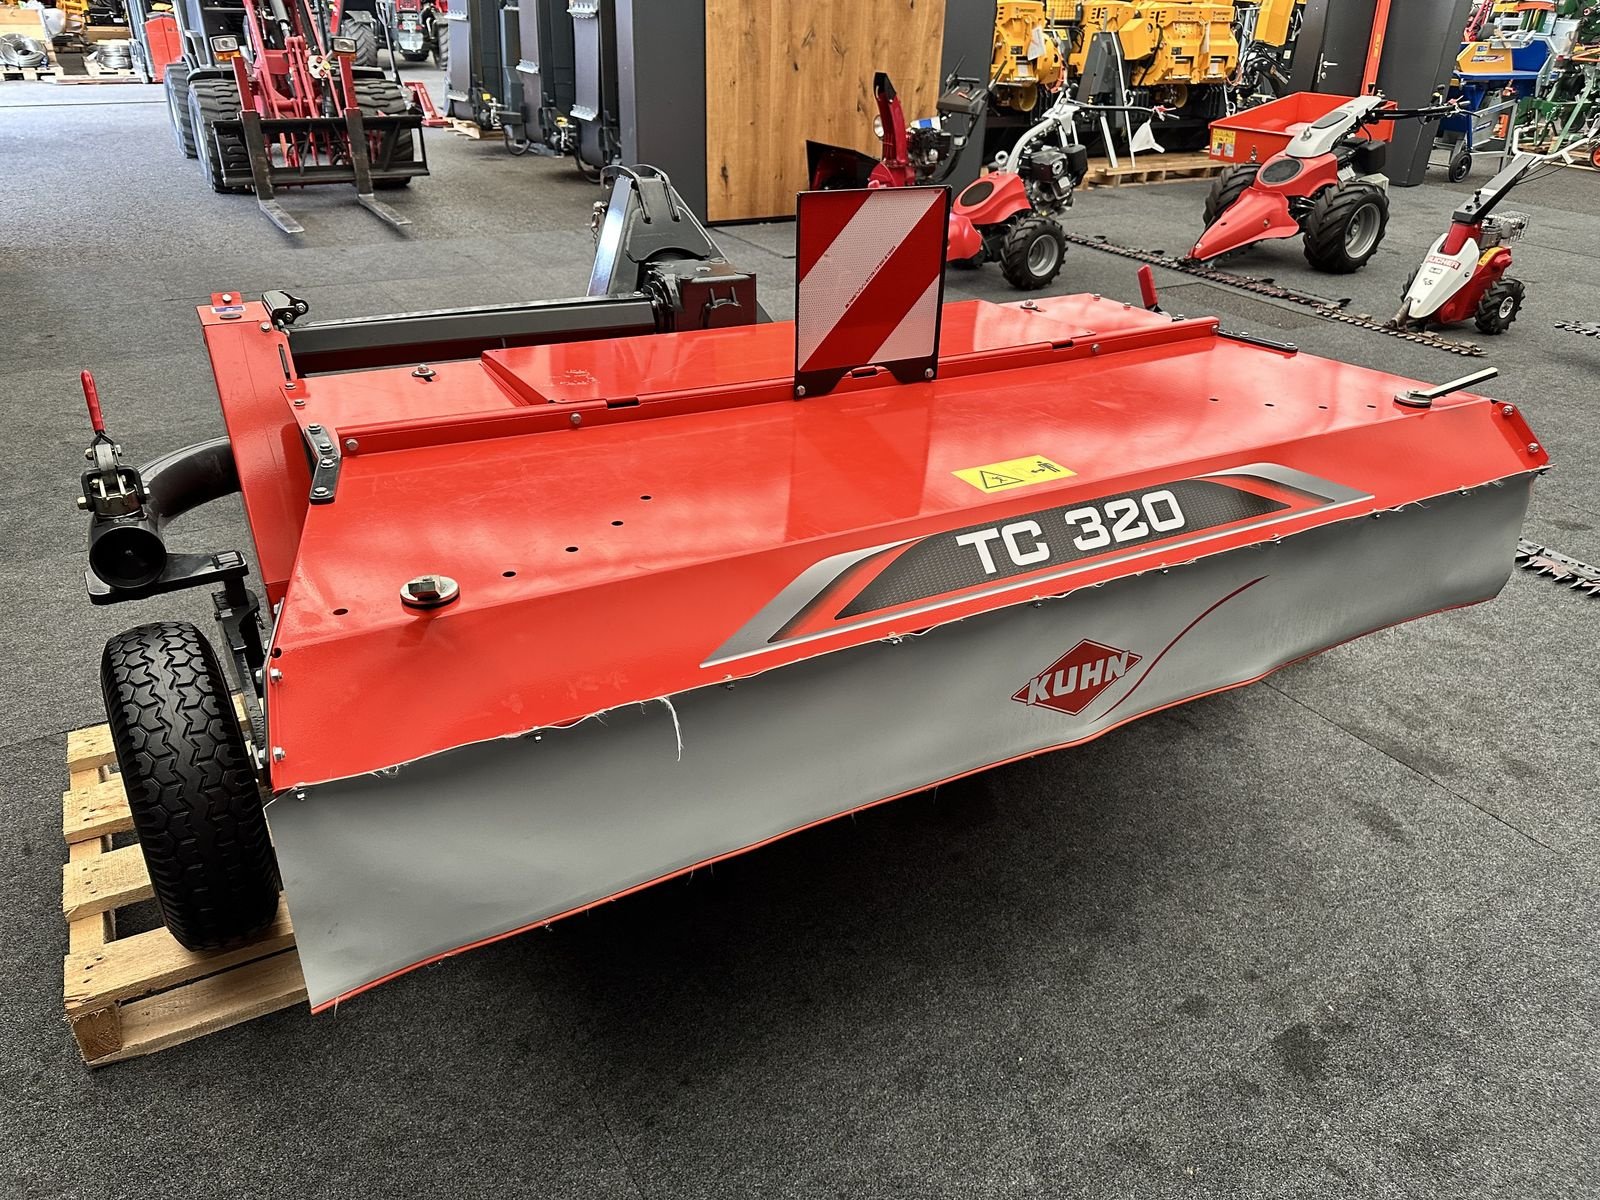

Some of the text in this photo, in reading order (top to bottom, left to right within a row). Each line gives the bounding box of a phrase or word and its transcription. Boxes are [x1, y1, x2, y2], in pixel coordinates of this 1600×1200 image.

[956, 489, 1186, 575] TC 320
[1026, 650, 1130, 706] KUHN
